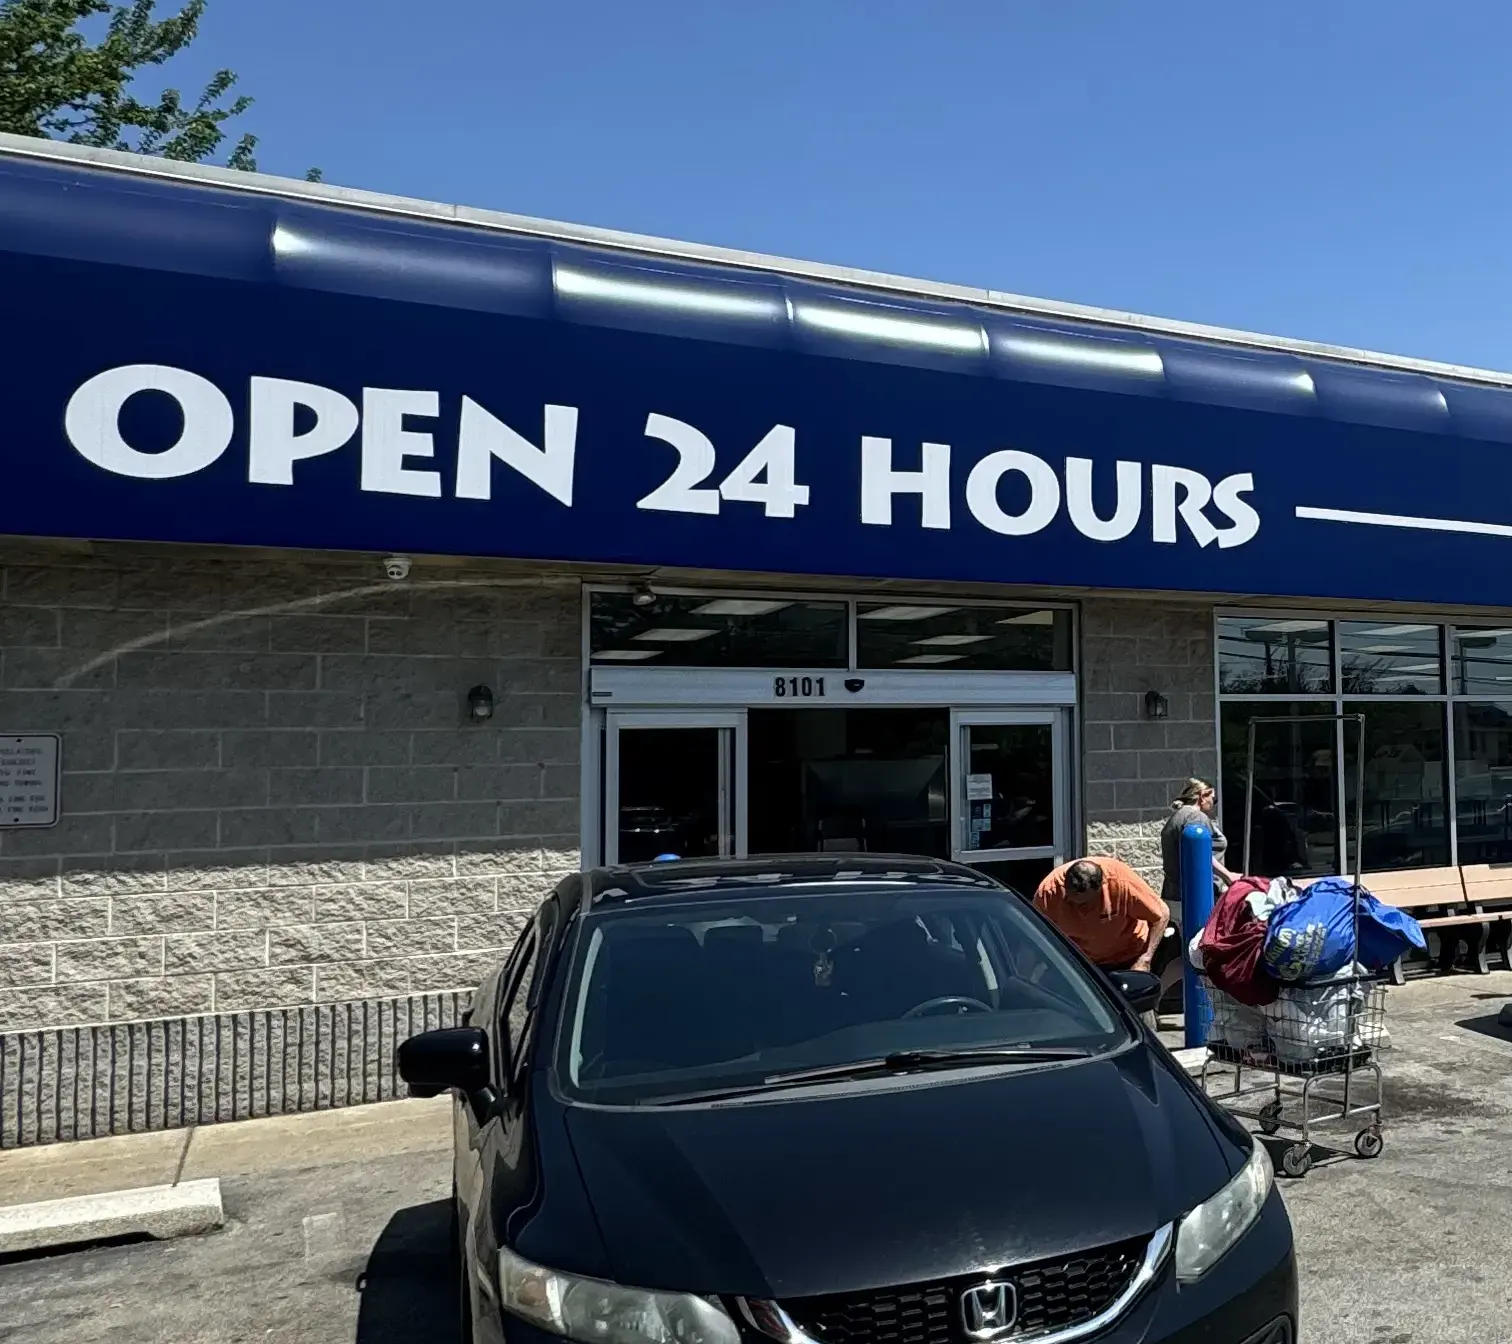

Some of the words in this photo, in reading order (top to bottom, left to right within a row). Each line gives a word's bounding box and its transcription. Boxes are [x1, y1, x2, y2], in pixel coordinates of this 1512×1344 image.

[65, 364, 579, 507] OPEN
[636, 412, 810, 519] 24
[861, 435, 1261, 549] HOURS
[775, 676, 825, 697] 8101
